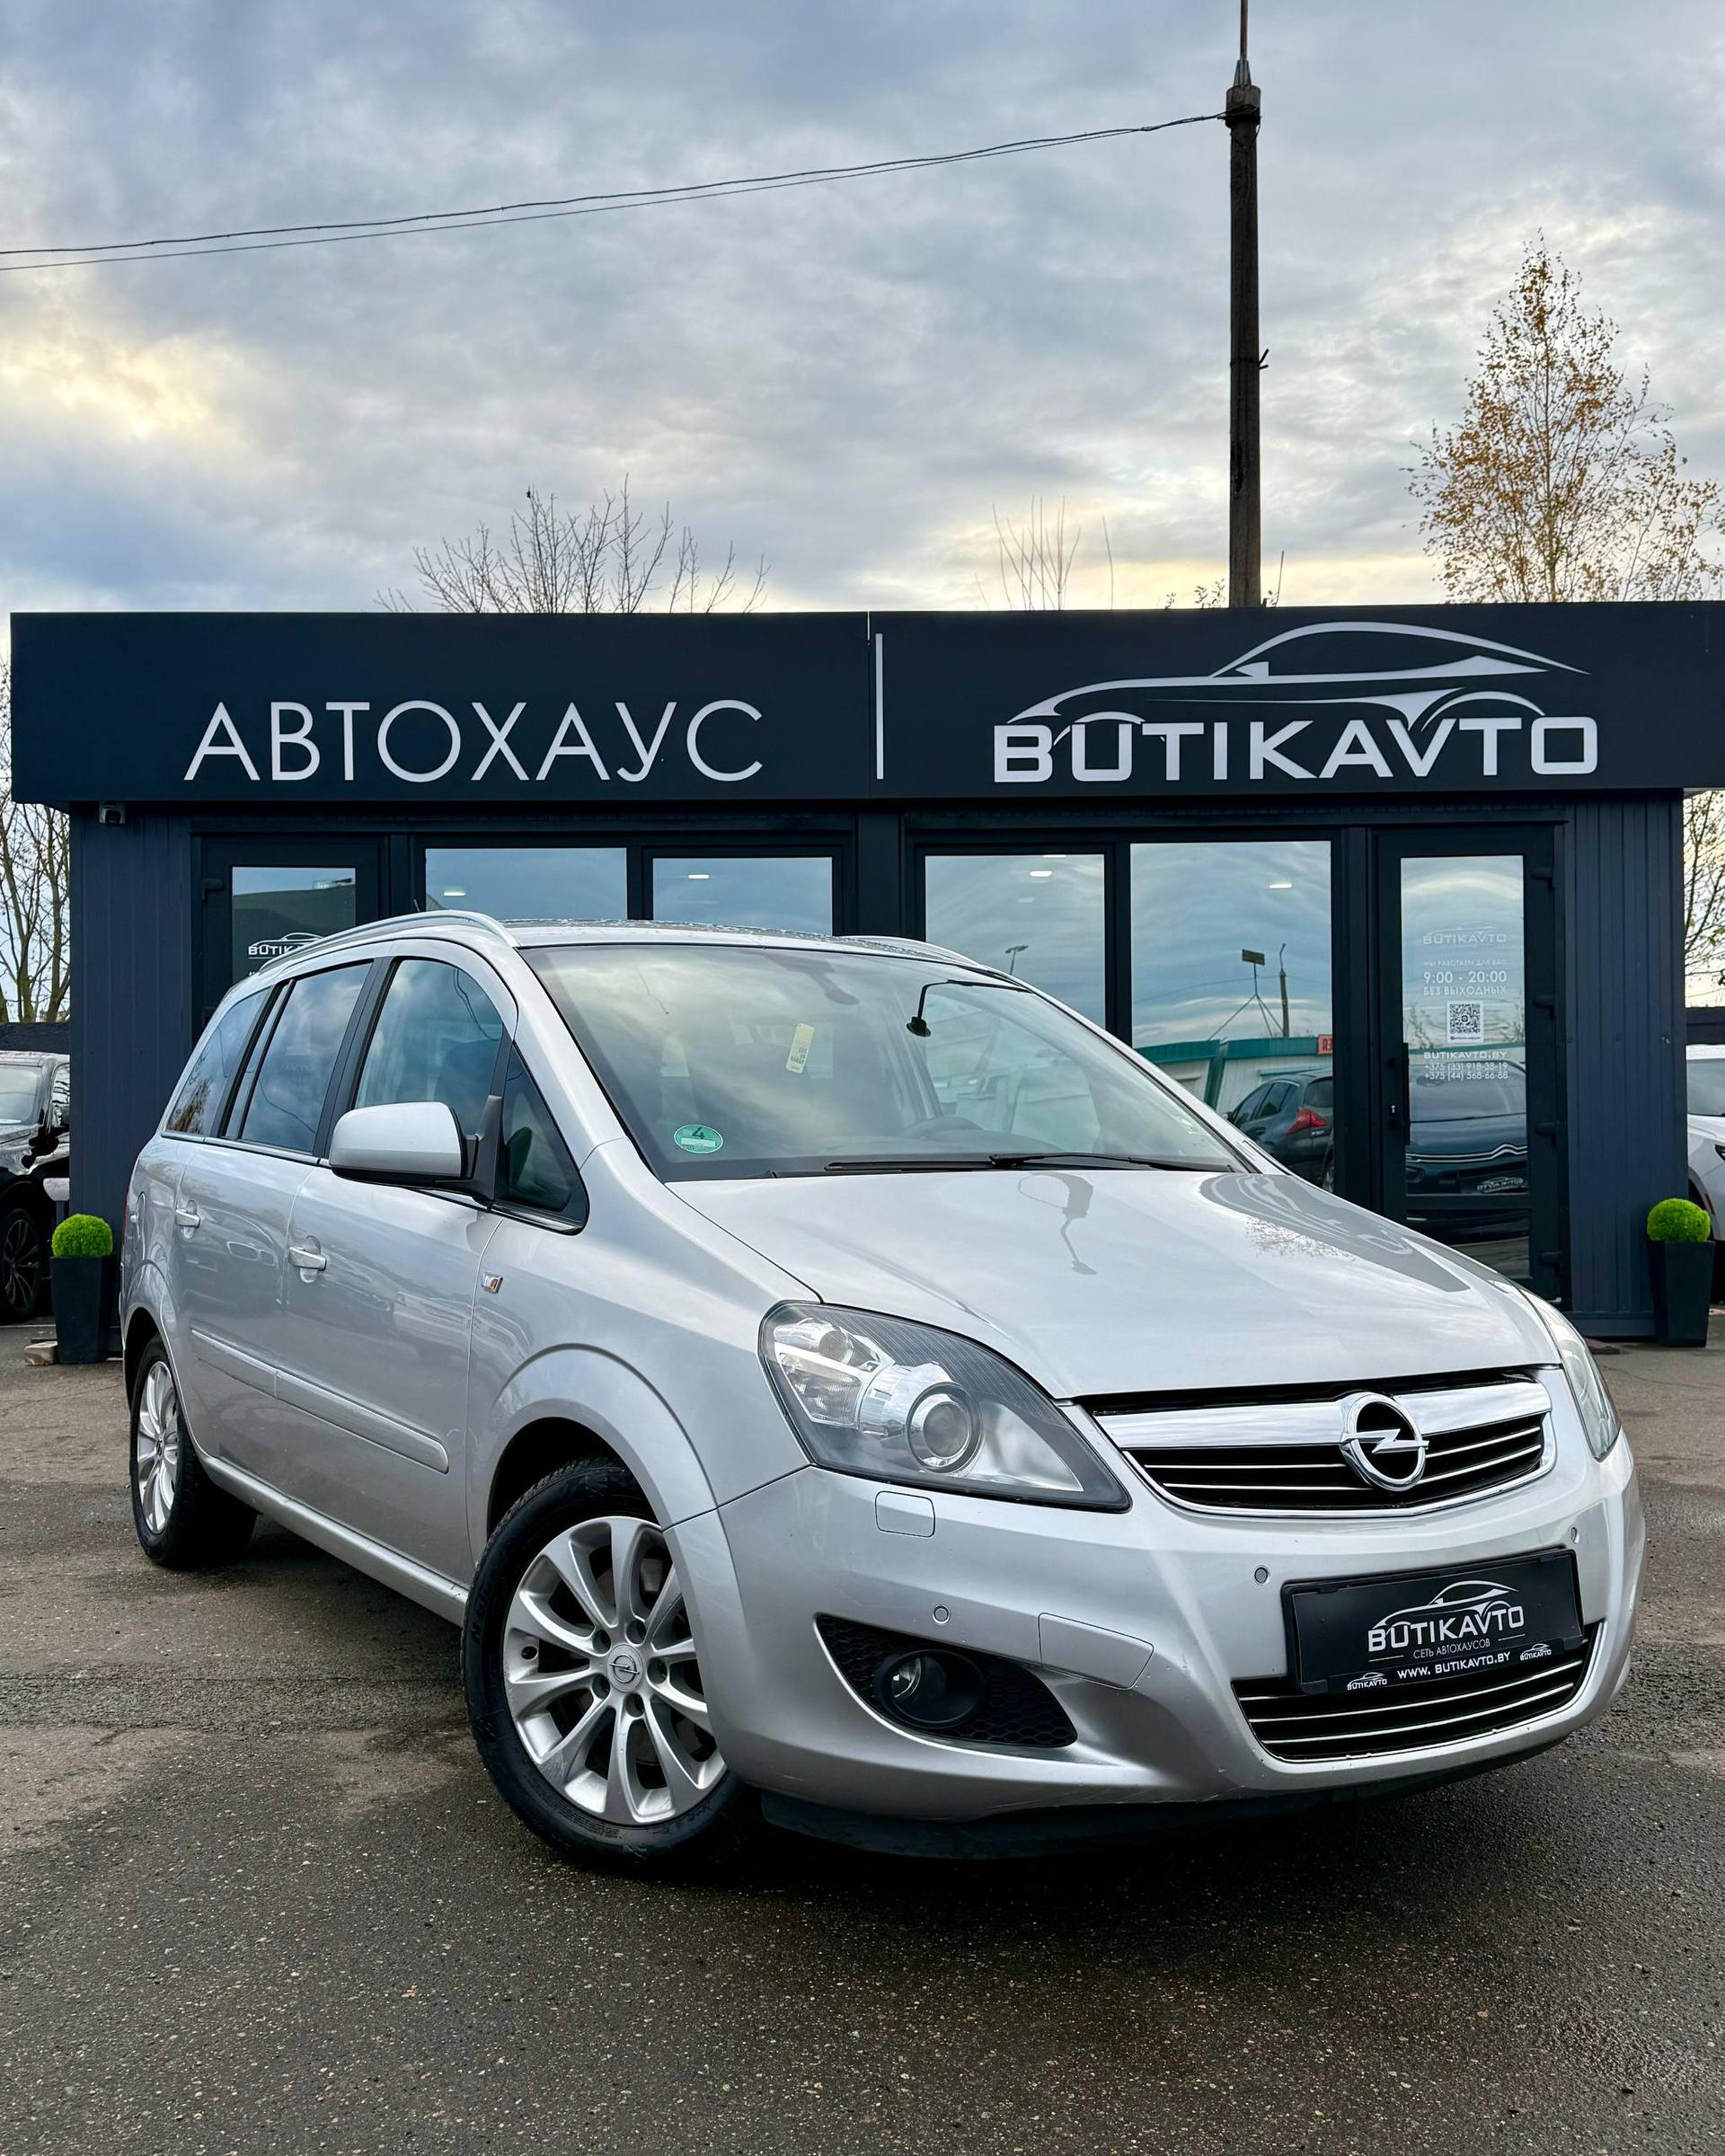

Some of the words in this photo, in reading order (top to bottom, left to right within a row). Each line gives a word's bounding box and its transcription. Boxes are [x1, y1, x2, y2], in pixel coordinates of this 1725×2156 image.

[184, 699, 764, 783] АВТОХАУС
[993, 716, 1598, 783] BUTIKAVTO
[1422, 933, 1507, 944] BUTIKAVTO
[1423, 971, 1454, 984] 9:00
[1468, 970, 1508, 983] 20:00
[1423, 985, 1441, 996] БЕЗ
[1443, 985, 1507, 995] ВЫХОДНЫХ
[1423, 1051, 1508, 1059] BUTIKAVTO.BY
[1424, 1063, 1446, 1072] +375
[1465, 1062, 1508, 1071] 918-38-19
[1424, 1072, 1446, 1080] +375
[1367, 1605, 1525, 1652] BUTIKAVTO
[1412, 1648, 1434, 1659] СЕТЬ
[1436, 1639, 1491, 1657] АВТОХАУСОВ
[1520, 1648, 1552, 1661] BUTIKAVTO
[1435, 1652, 1511, 1674] BUTIKAVTO.BY
[1347, 1678, 1387, 1691] BUTIKAVTO
